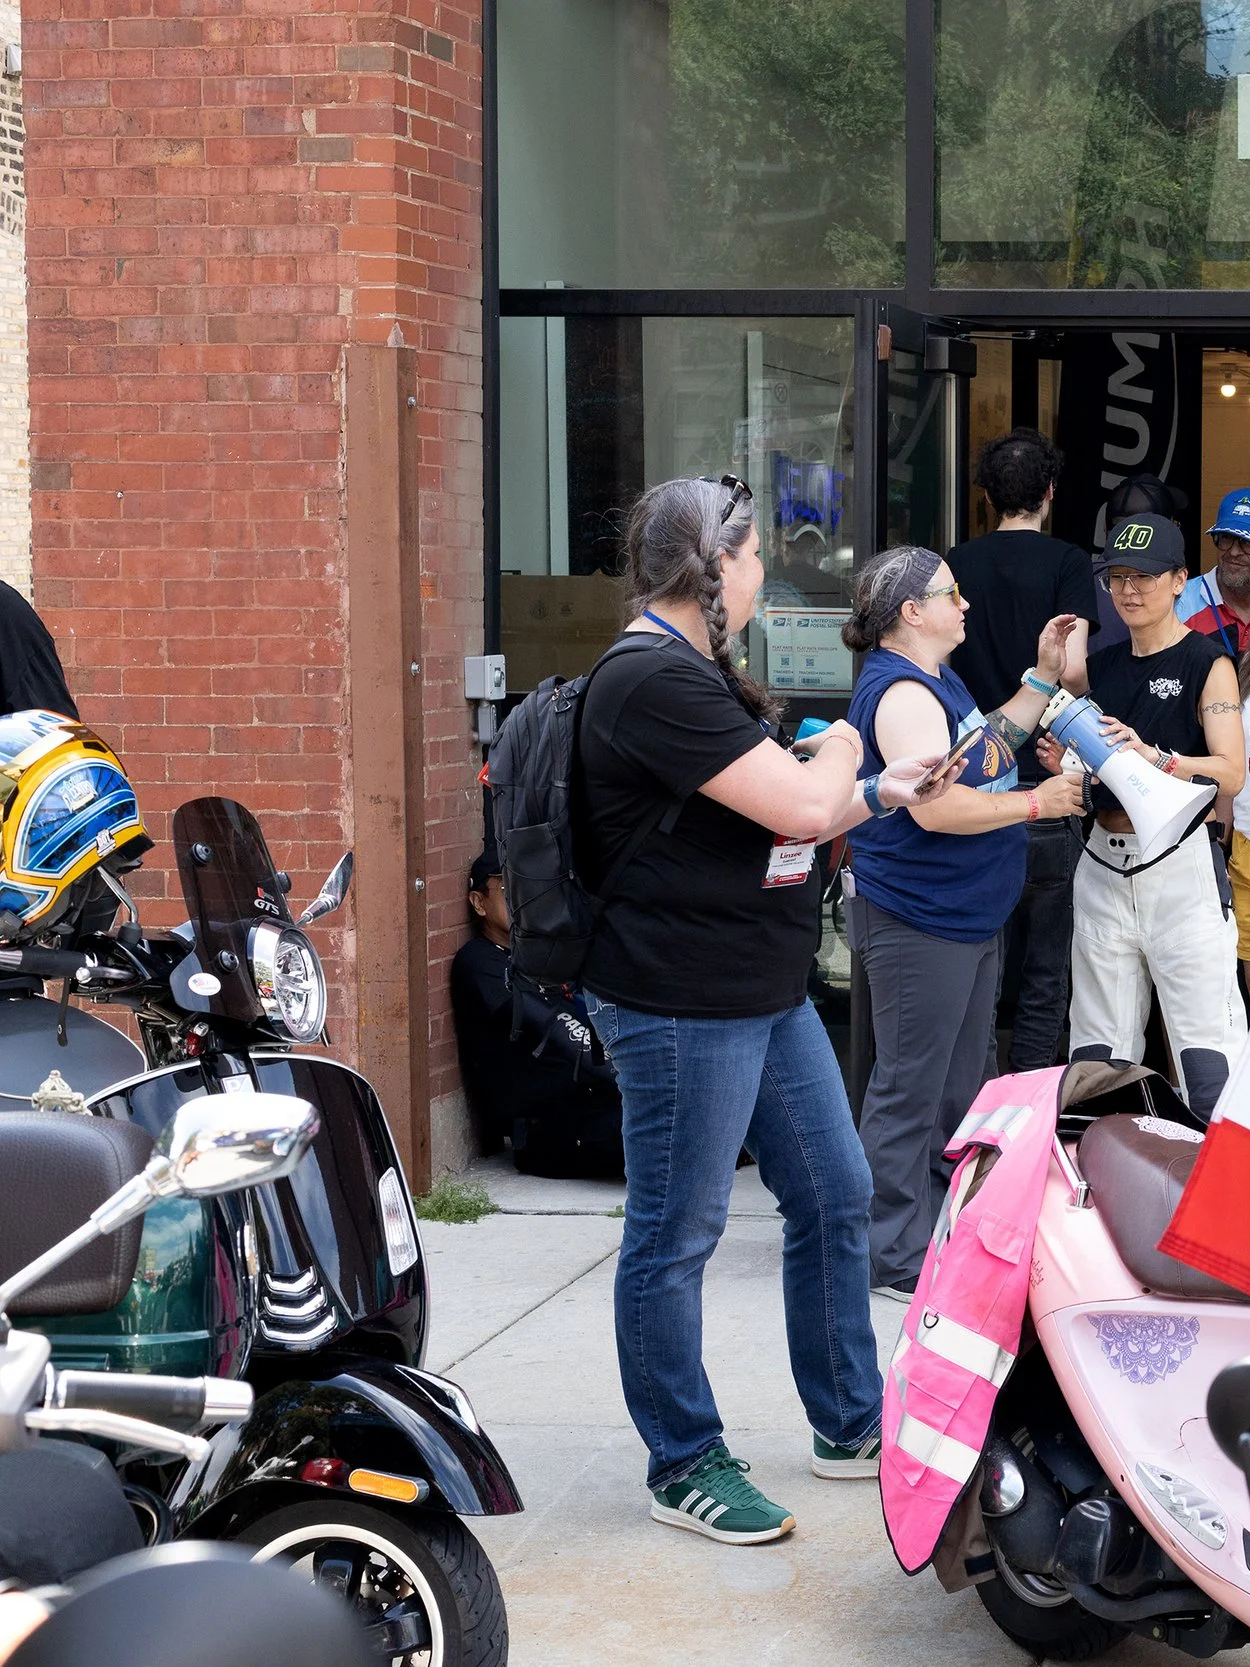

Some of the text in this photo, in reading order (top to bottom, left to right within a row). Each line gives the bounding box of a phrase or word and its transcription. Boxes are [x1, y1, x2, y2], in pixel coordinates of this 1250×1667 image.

[1114, 523, 1154, 550] 40
[779, 851, 803, 860] Linzee
[253, 898, 280, 916] GTS
